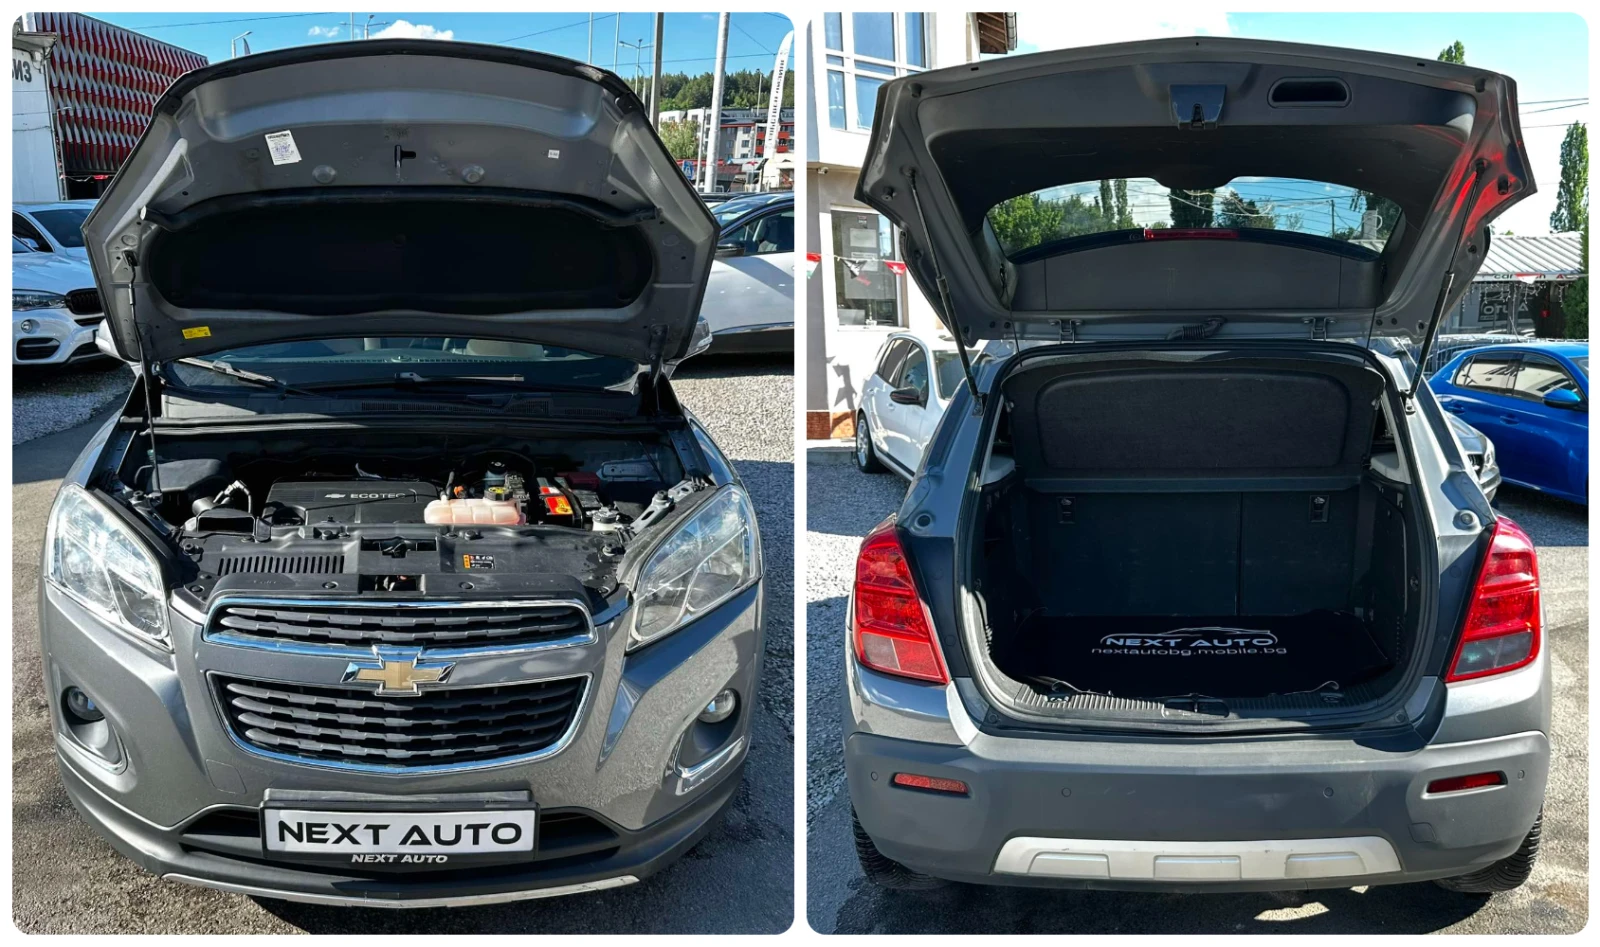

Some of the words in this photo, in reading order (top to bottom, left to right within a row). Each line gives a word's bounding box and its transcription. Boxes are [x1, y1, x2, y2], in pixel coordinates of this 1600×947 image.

[12, 58, 32, 83] ИЗ
[350, 492, 406, 500] ECOTEC
[1106, 638, 1182, 647] NEXT
[1189, 638, 1274, 647] AUTO
[1091, 647, 1288, 657] nextautobg.mobile.bg
[278, 820, 390, 846] NEXT
[398, 822, 523, 847] AUTO
[351, 853, 398, 864] NEXT
[400, 854, 448, 864] AUTO
